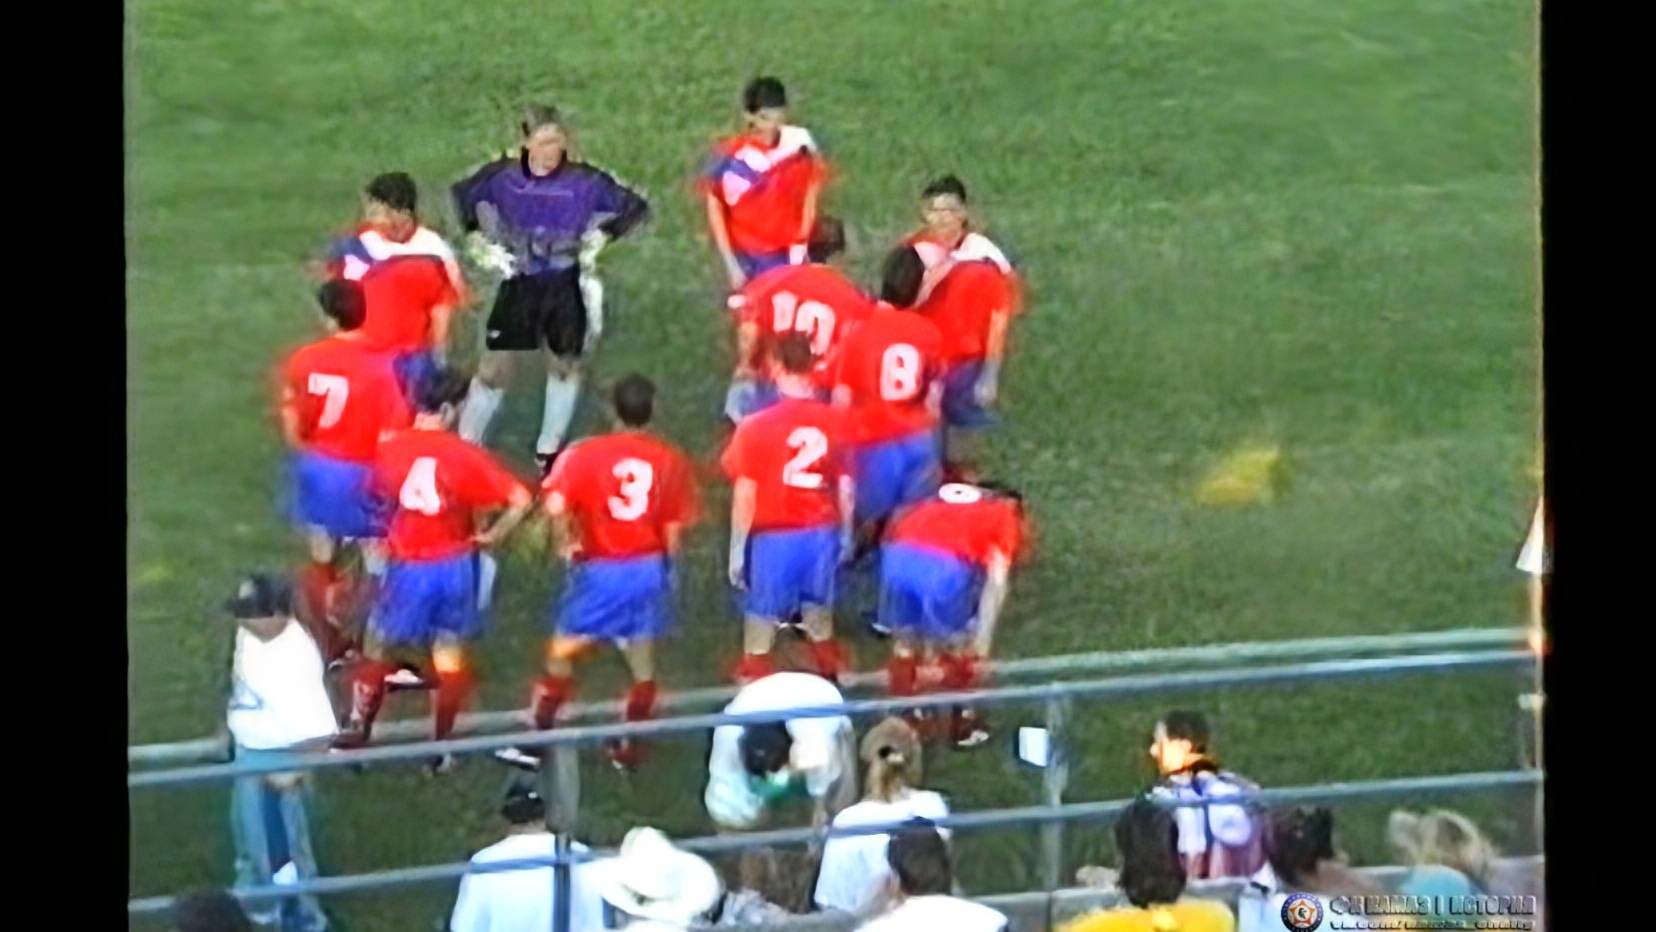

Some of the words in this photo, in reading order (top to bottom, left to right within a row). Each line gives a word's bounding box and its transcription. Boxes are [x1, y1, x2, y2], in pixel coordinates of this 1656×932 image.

[307, 372, 350, 428] 7
[880, 342, 920, 401] 8
[400, 456, 441, 516] 4
[782, 426, 828, 488] 2
[608, 457, 653, 521] 3
